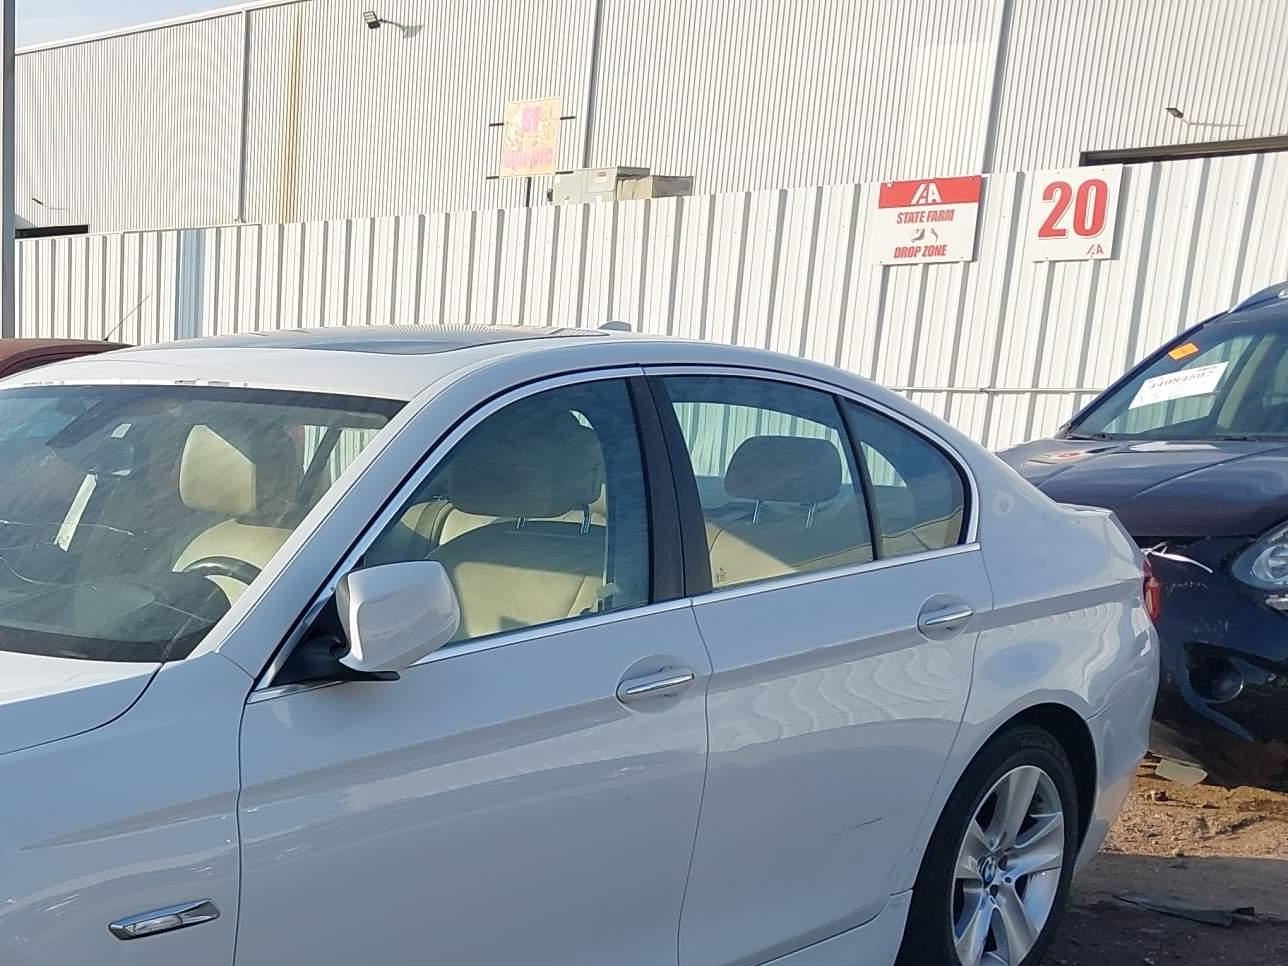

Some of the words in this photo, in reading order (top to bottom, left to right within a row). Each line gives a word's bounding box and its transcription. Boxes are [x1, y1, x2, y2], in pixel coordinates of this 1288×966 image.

[896, 211, 925, 224] STATE
[927, 209, 955, 222] FARM
[1038, 179, 1109, 239] 20
[894, 245, 921, 258] DROP
[922, 244, 948, 257] ZONE
